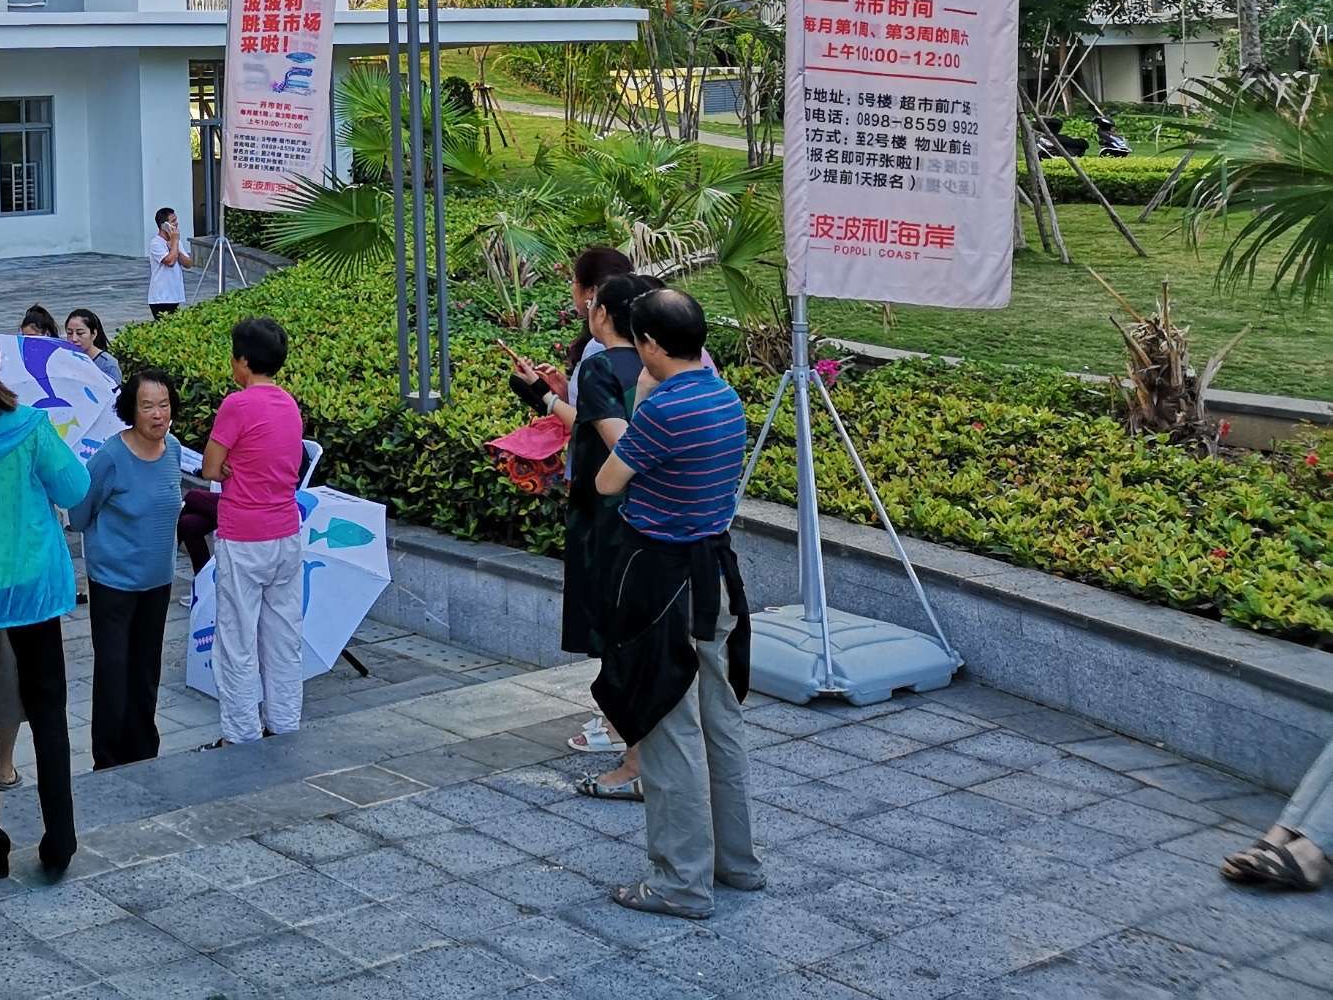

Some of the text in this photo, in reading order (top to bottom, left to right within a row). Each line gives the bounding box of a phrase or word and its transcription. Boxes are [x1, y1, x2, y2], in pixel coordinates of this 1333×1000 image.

[241, 12, 322, 34] 跳蚤市场
[240, 33, 289, 55] 来啦！
[821, 42, 961, 69] 上午10:00-12:00
[899, 95, 972, 117] 超市前广场
[914, 136, 972, 155] 物业前台
[809, 213, 955, 249] 波波利海岸
[834, 245, 920, 261] POPOLI COAST
